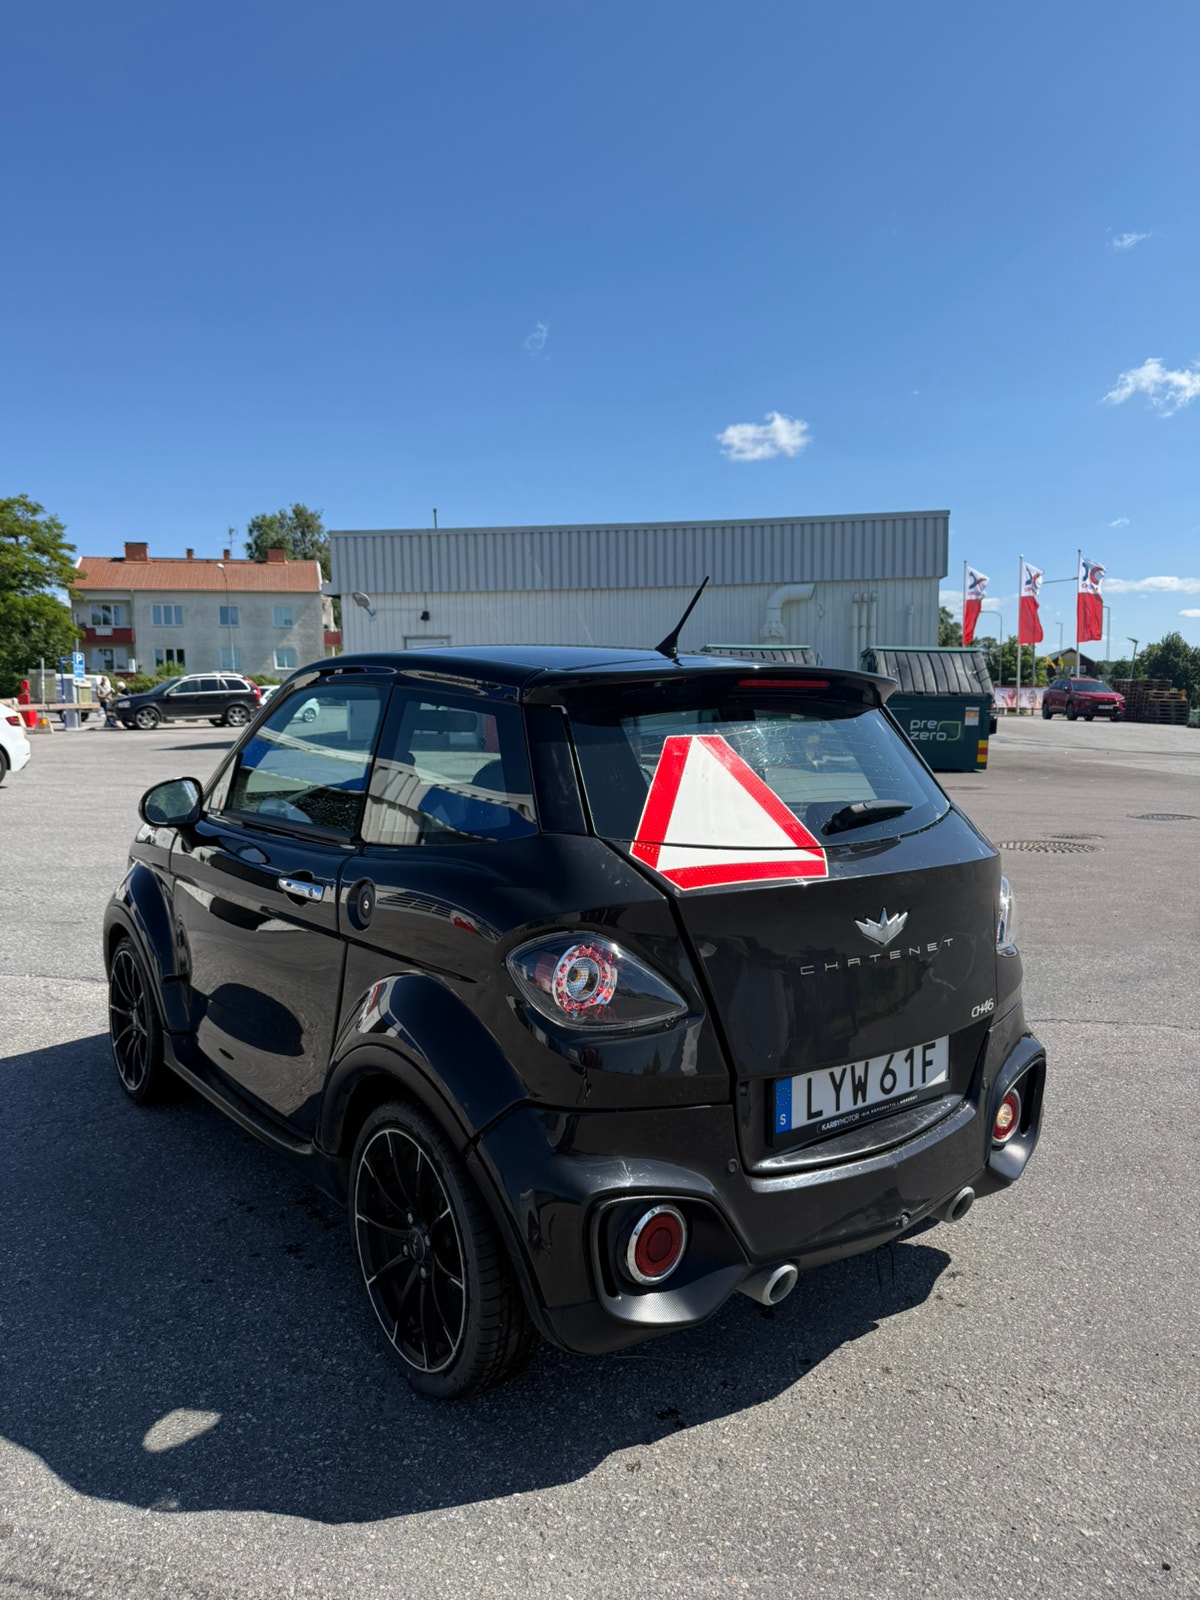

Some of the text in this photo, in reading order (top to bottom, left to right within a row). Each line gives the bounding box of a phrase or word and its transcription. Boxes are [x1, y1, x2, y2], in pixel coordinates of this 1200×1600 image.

[76, 654, 83, 665] P
[910, 719, 938, 731] pre
[910, 731, 947, 741] zero
[800, 938, 954, 976] CHATENET
[971, 998, 995, 1018] CH46
[806, 1042, 936, 1121] LYW 61F
[779, 1113, 787, 1126] S
